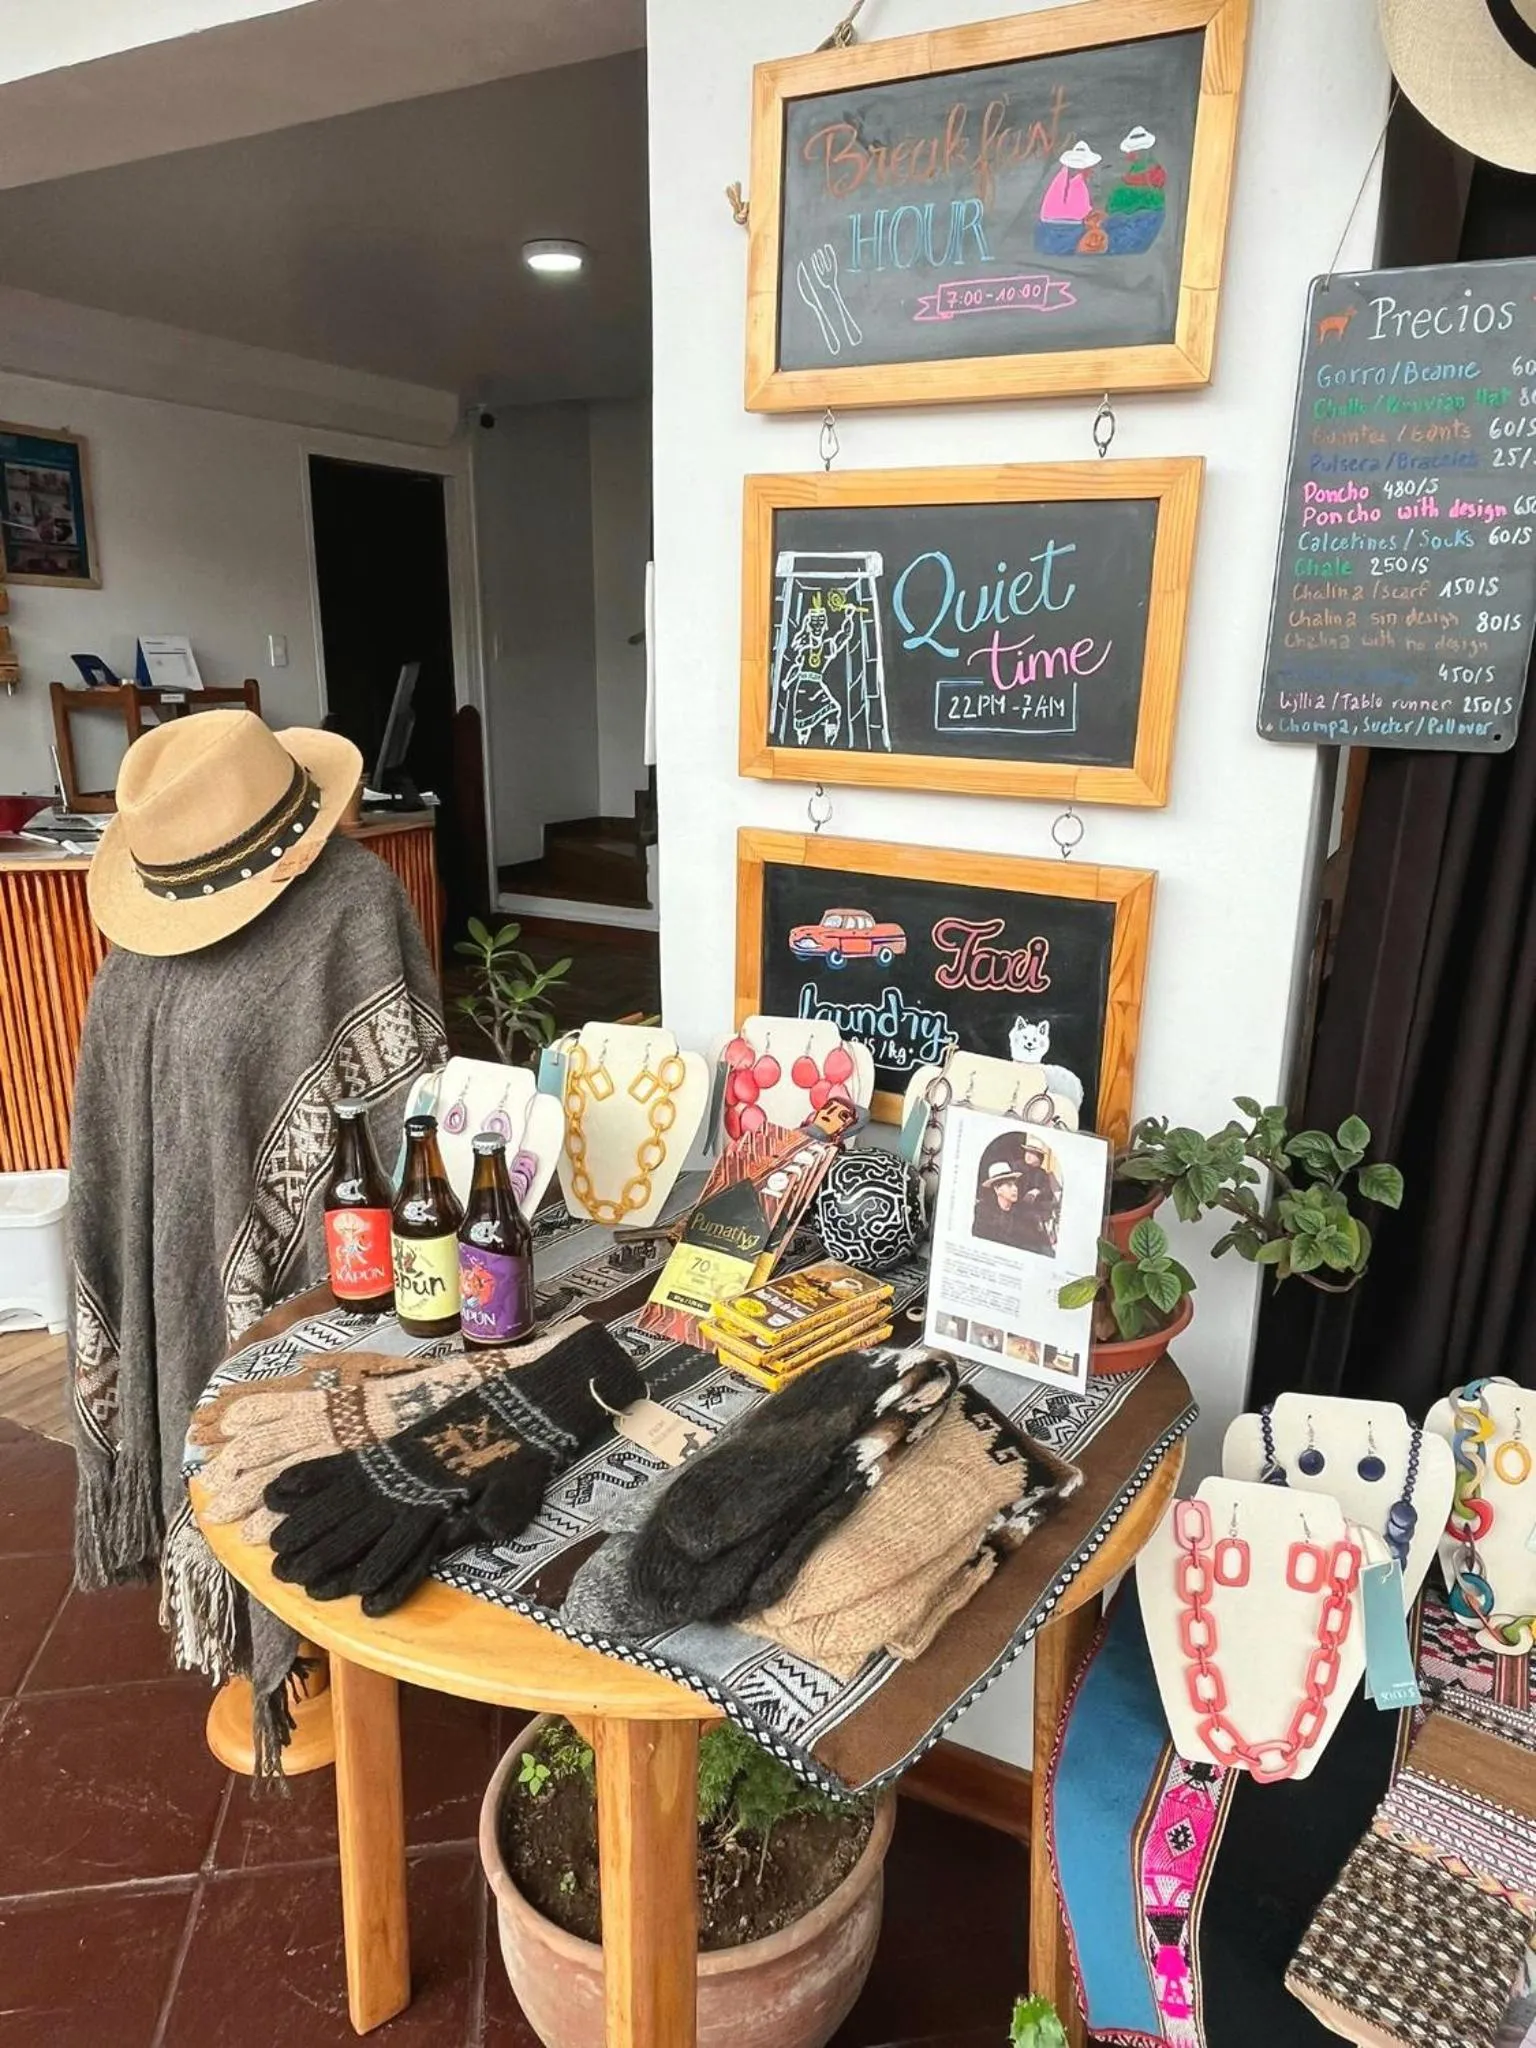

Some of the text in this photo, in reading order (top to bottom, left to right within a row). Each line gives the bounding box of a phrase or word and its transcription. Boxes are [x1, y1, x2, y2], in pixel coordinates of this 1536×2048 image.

[804, 84, 1072, 200] Breakfast
[846, 198, 994, 272] HOUR
[1367, 289, 1516, 340] Precios
[1492, 447, 1536, 469] 25/
[1304, 480, 1369, 504] Poncho
[1302, 503, 1381, 527] Poncho
[1397, 496, 1439, 520] with
[1449, 498, 1507, 523] design
[1299, 530, 1397, 552] Calcetines
[1489, 526, 1532, 546] 60/S
[893, 539, 1076, 657] Quiet
[1370, 612, 1397, 626] sin
[1405, 607, 1459, 630] design
[1476, 611, 1522, 633] 80/S
[1362, 629, 1395, 648] with
[1406, 638, 1426, 651] no
[1435, 634, 1488, 659] design
[967, 630, 1112, 690] time
[1392, 699, 1453, 712] runner
[932, 917, 1050, 992] Taxi
